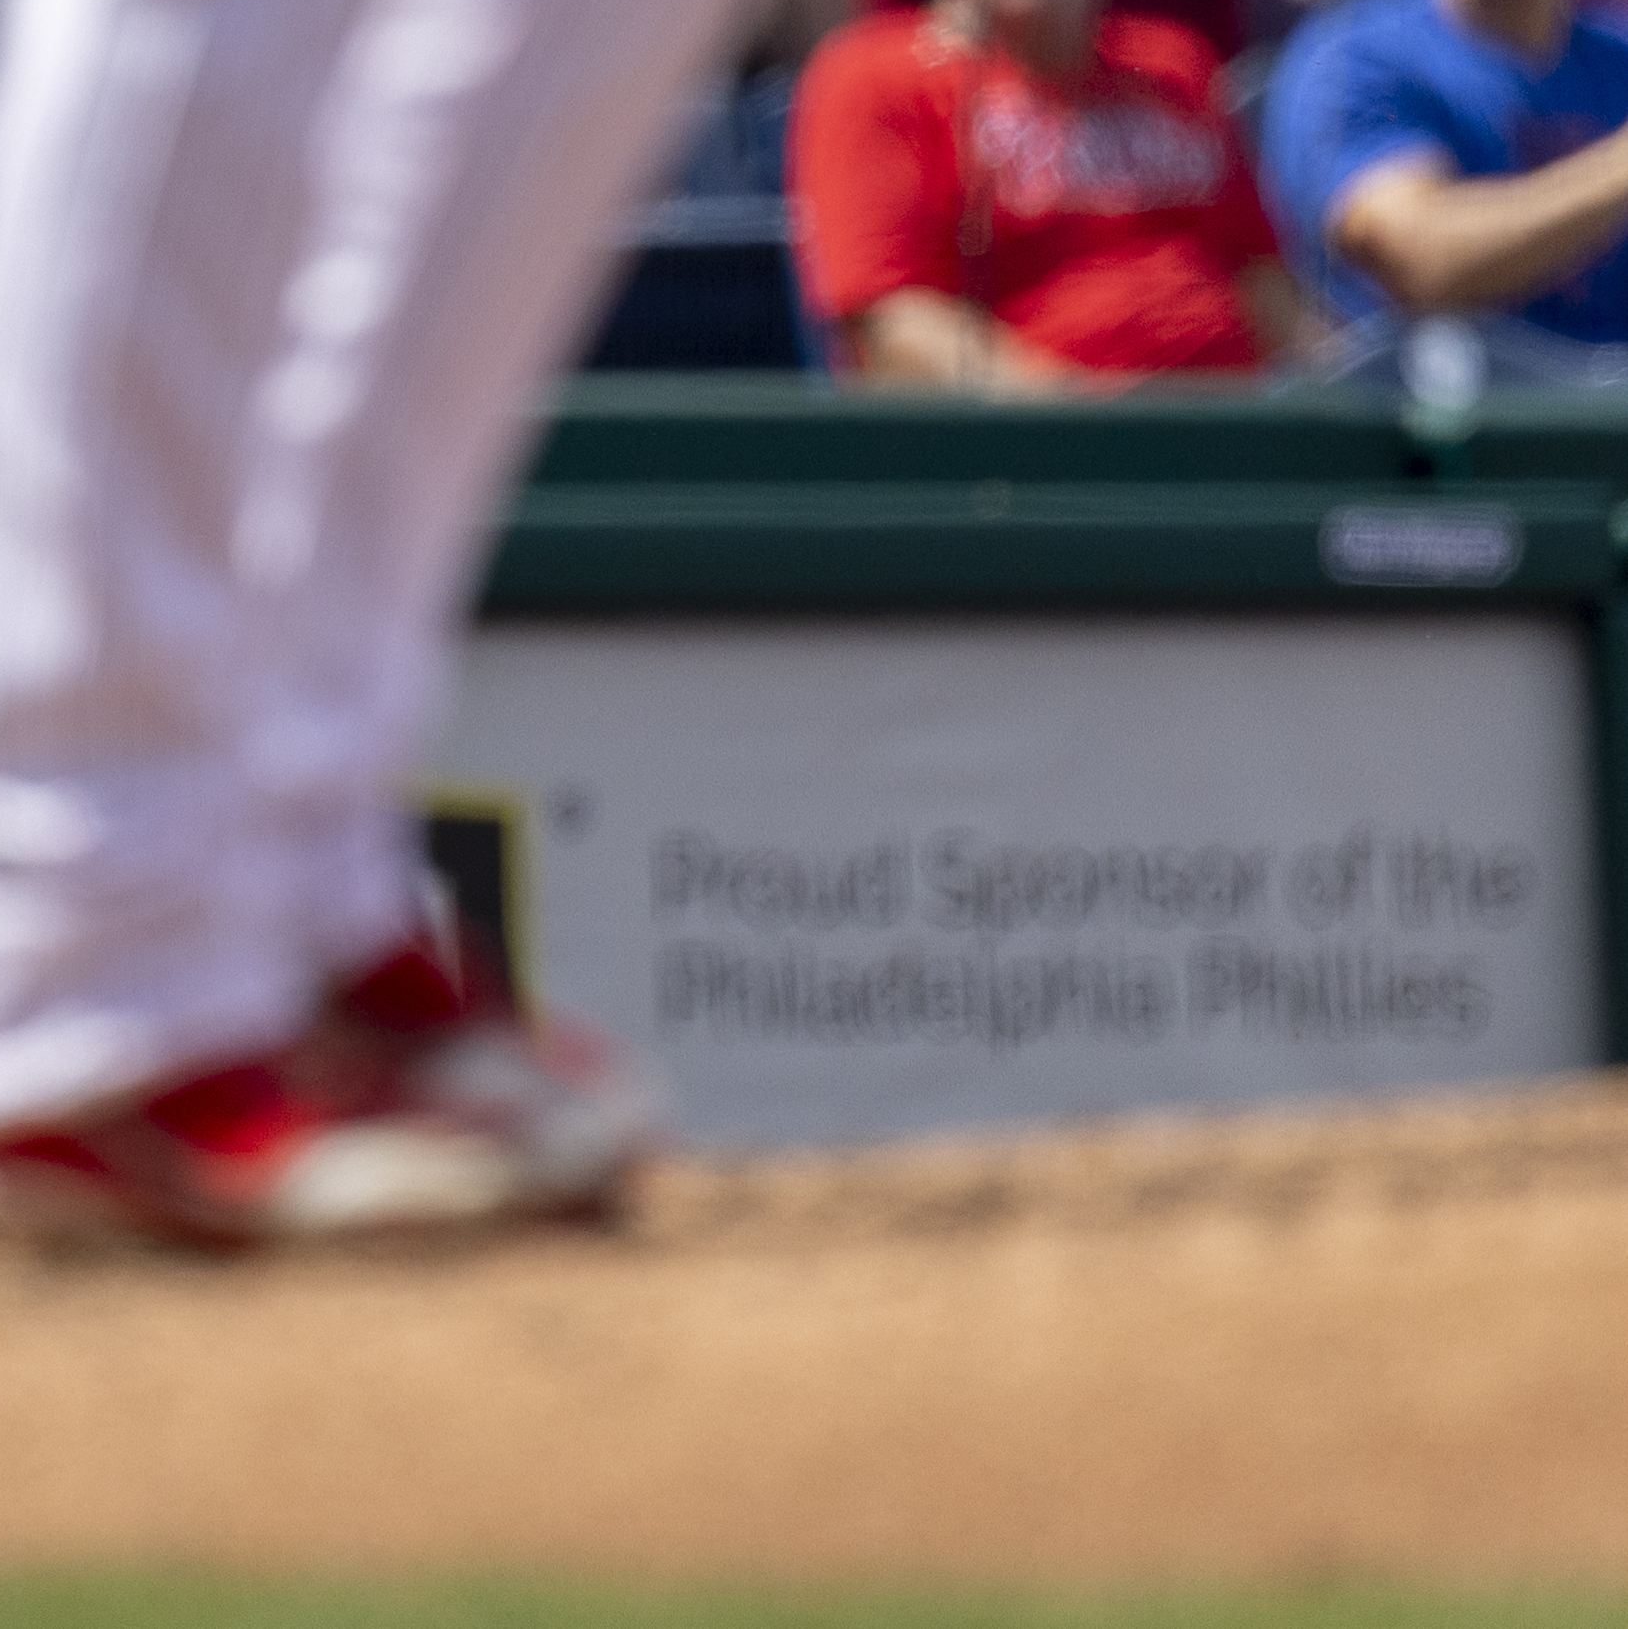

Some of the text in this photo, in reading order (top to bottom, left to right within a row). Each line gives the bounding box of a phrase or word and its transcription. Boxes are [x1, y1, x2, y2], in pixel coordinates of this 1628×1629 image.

[655, 823, 1534, 931] Proud Sponsor of the
[656, 941, 1490, 1053] Philadelphia Phillies
